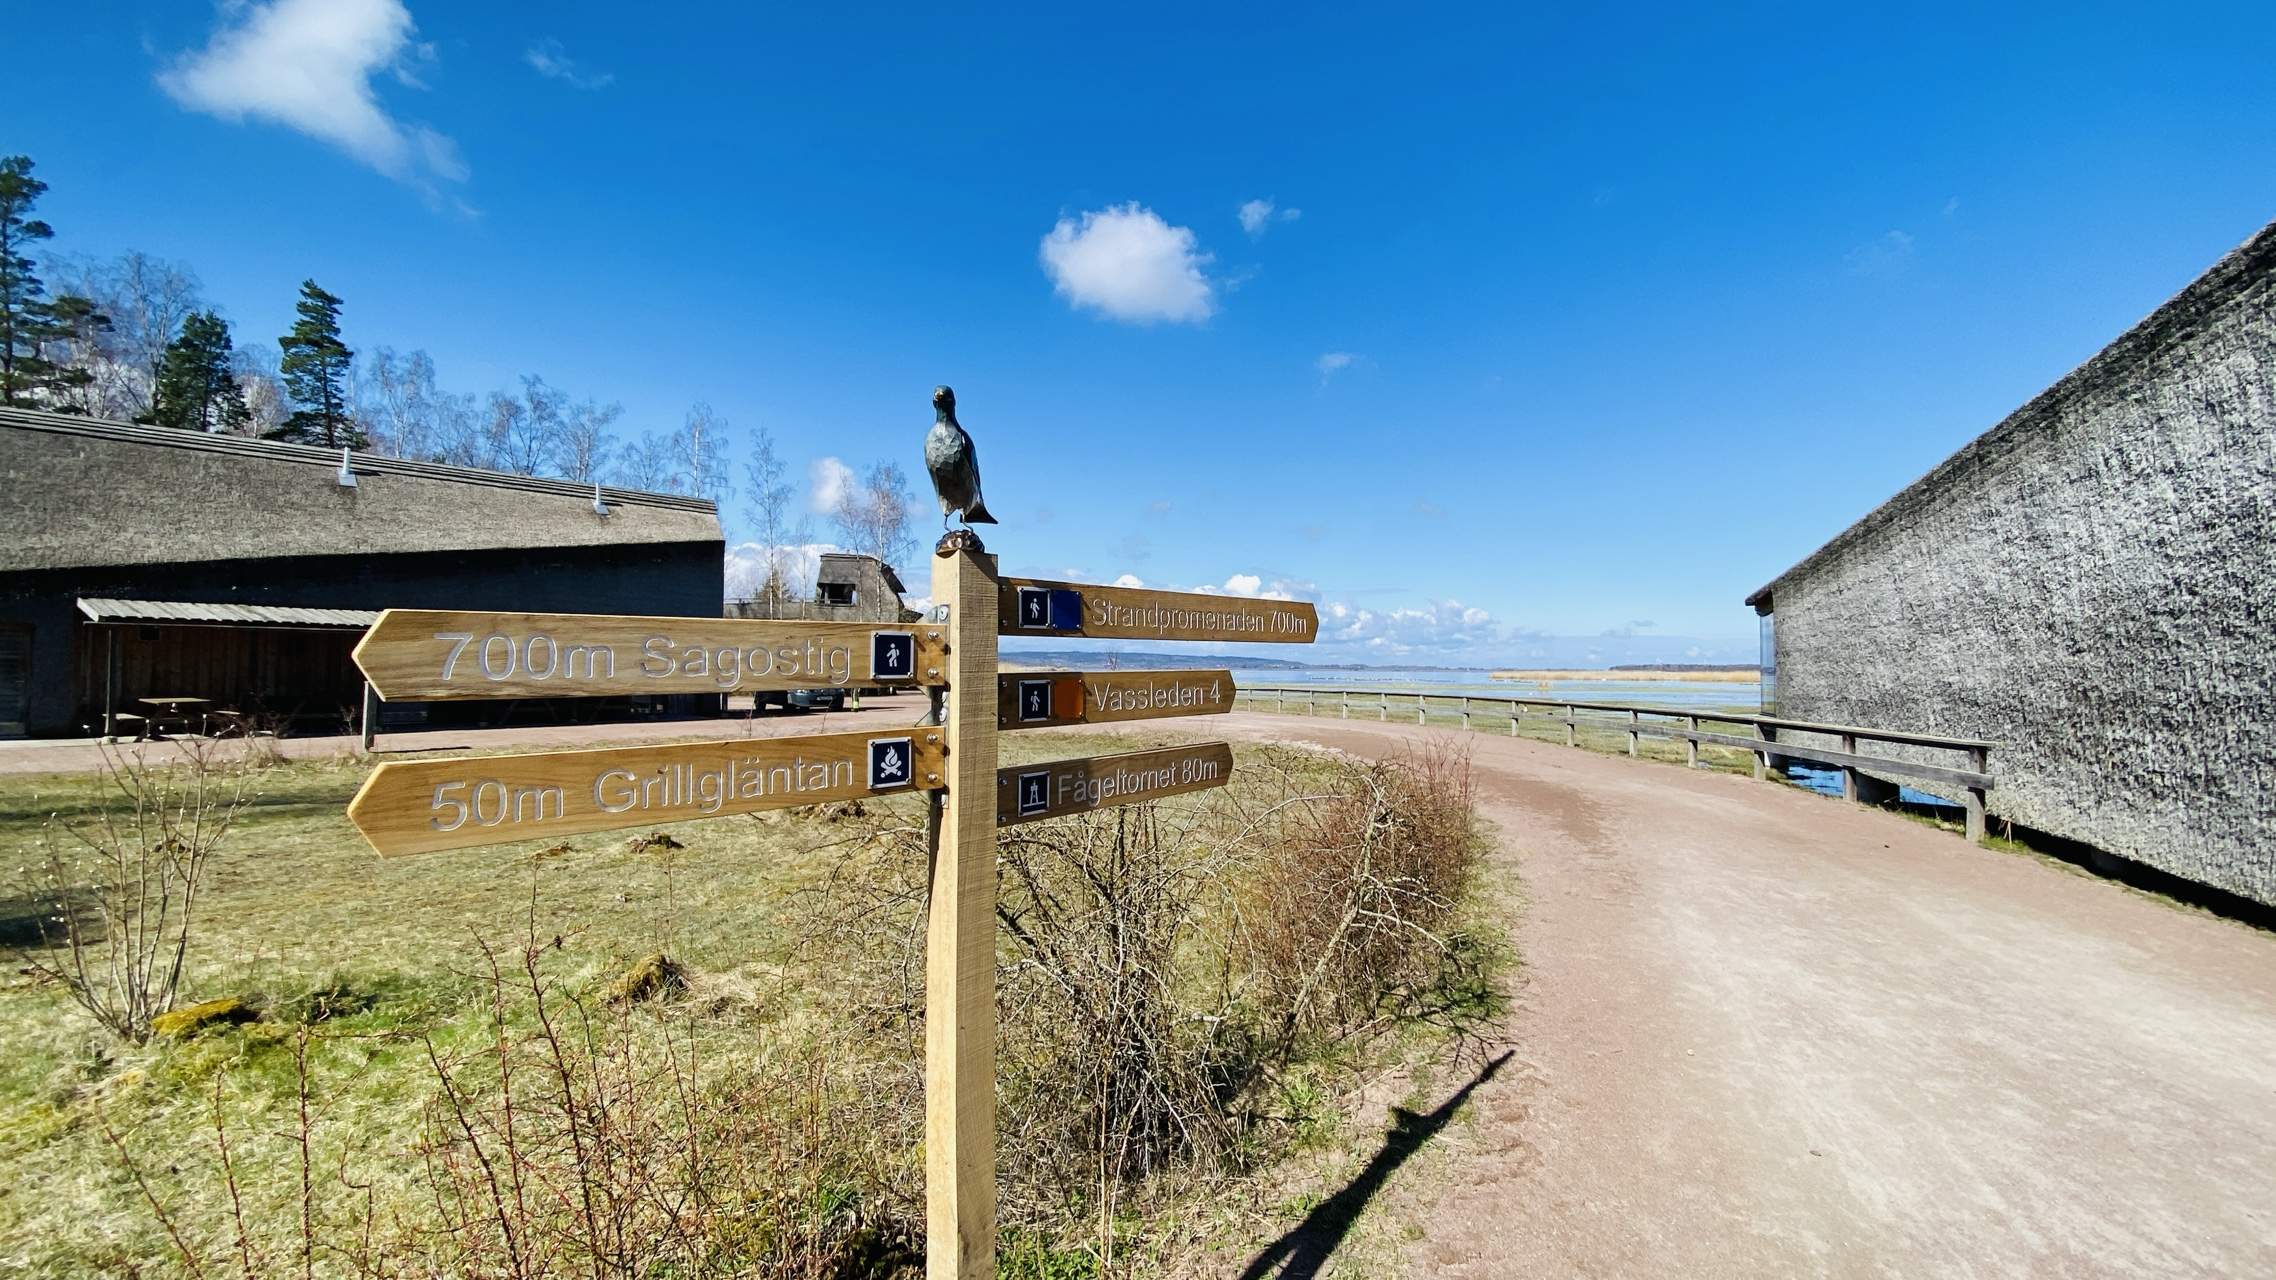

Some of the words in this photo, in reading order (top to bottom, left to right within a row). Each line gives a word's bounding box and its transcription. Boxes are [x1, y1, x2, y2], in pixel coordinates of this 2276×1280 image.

[1092, 599, 1264, 633] Strandpromenaden
[1269, 610, 1308, 634] 700m
[433, 632, 614, 681] 700m
[641, 636, 852, 686] Sagostig
[1093, 681, 1204, 712] Vassleden
[1209, 679, 1221, 704] 4
[431, 778, 565, 832] 50m
[594, 756, 853, 813] Grillgläntan
[1057, 765, 1176, 806] Fågeltornet
[1182, 758, 1218, 783] 80m
